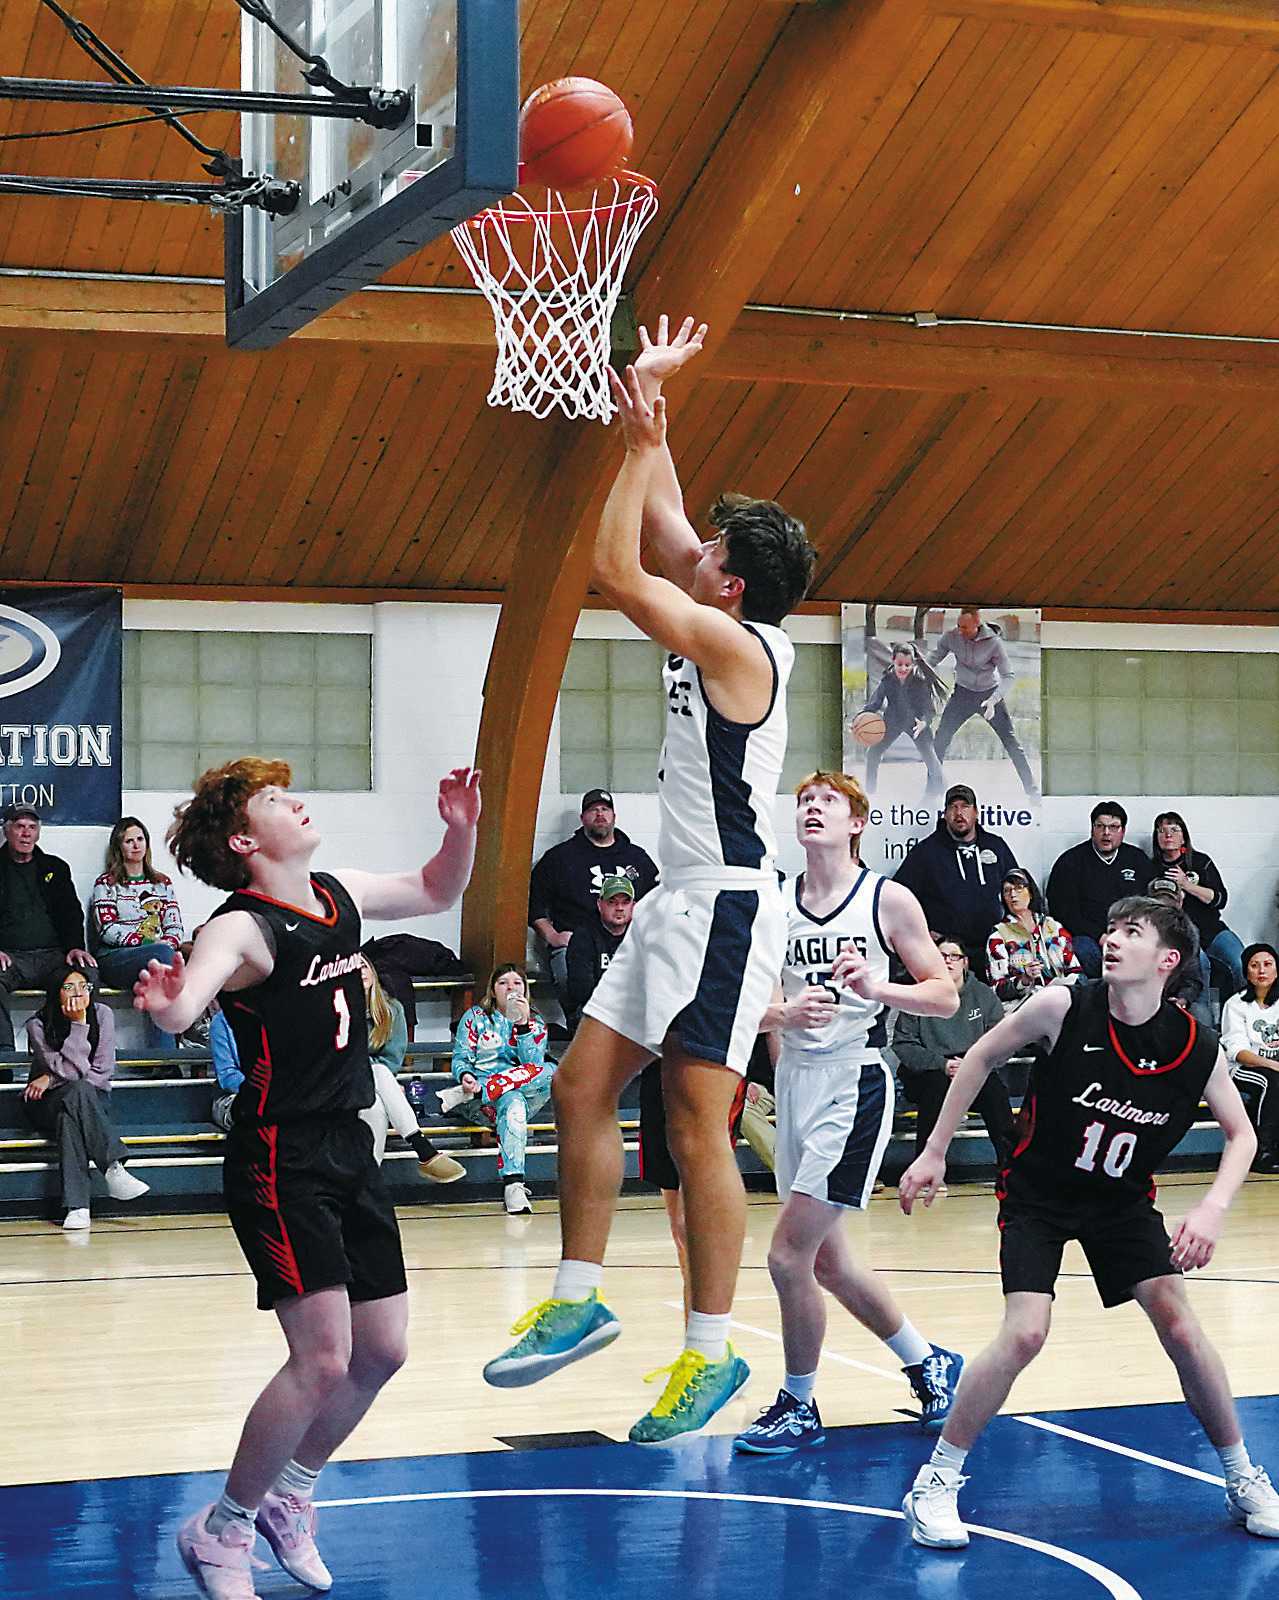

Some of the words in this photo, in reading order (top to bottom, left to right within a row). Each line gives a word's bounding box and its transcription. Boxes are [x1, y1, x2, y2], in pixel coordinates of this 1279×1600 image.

[0, 724, 112, 767] TION
[890, 804, 931, 826] the
[333, 987, 351, 1051] 1
[1071, 1082, 1171, 1126] Larimore
[1074, 1120, 1138, 1178] 10
